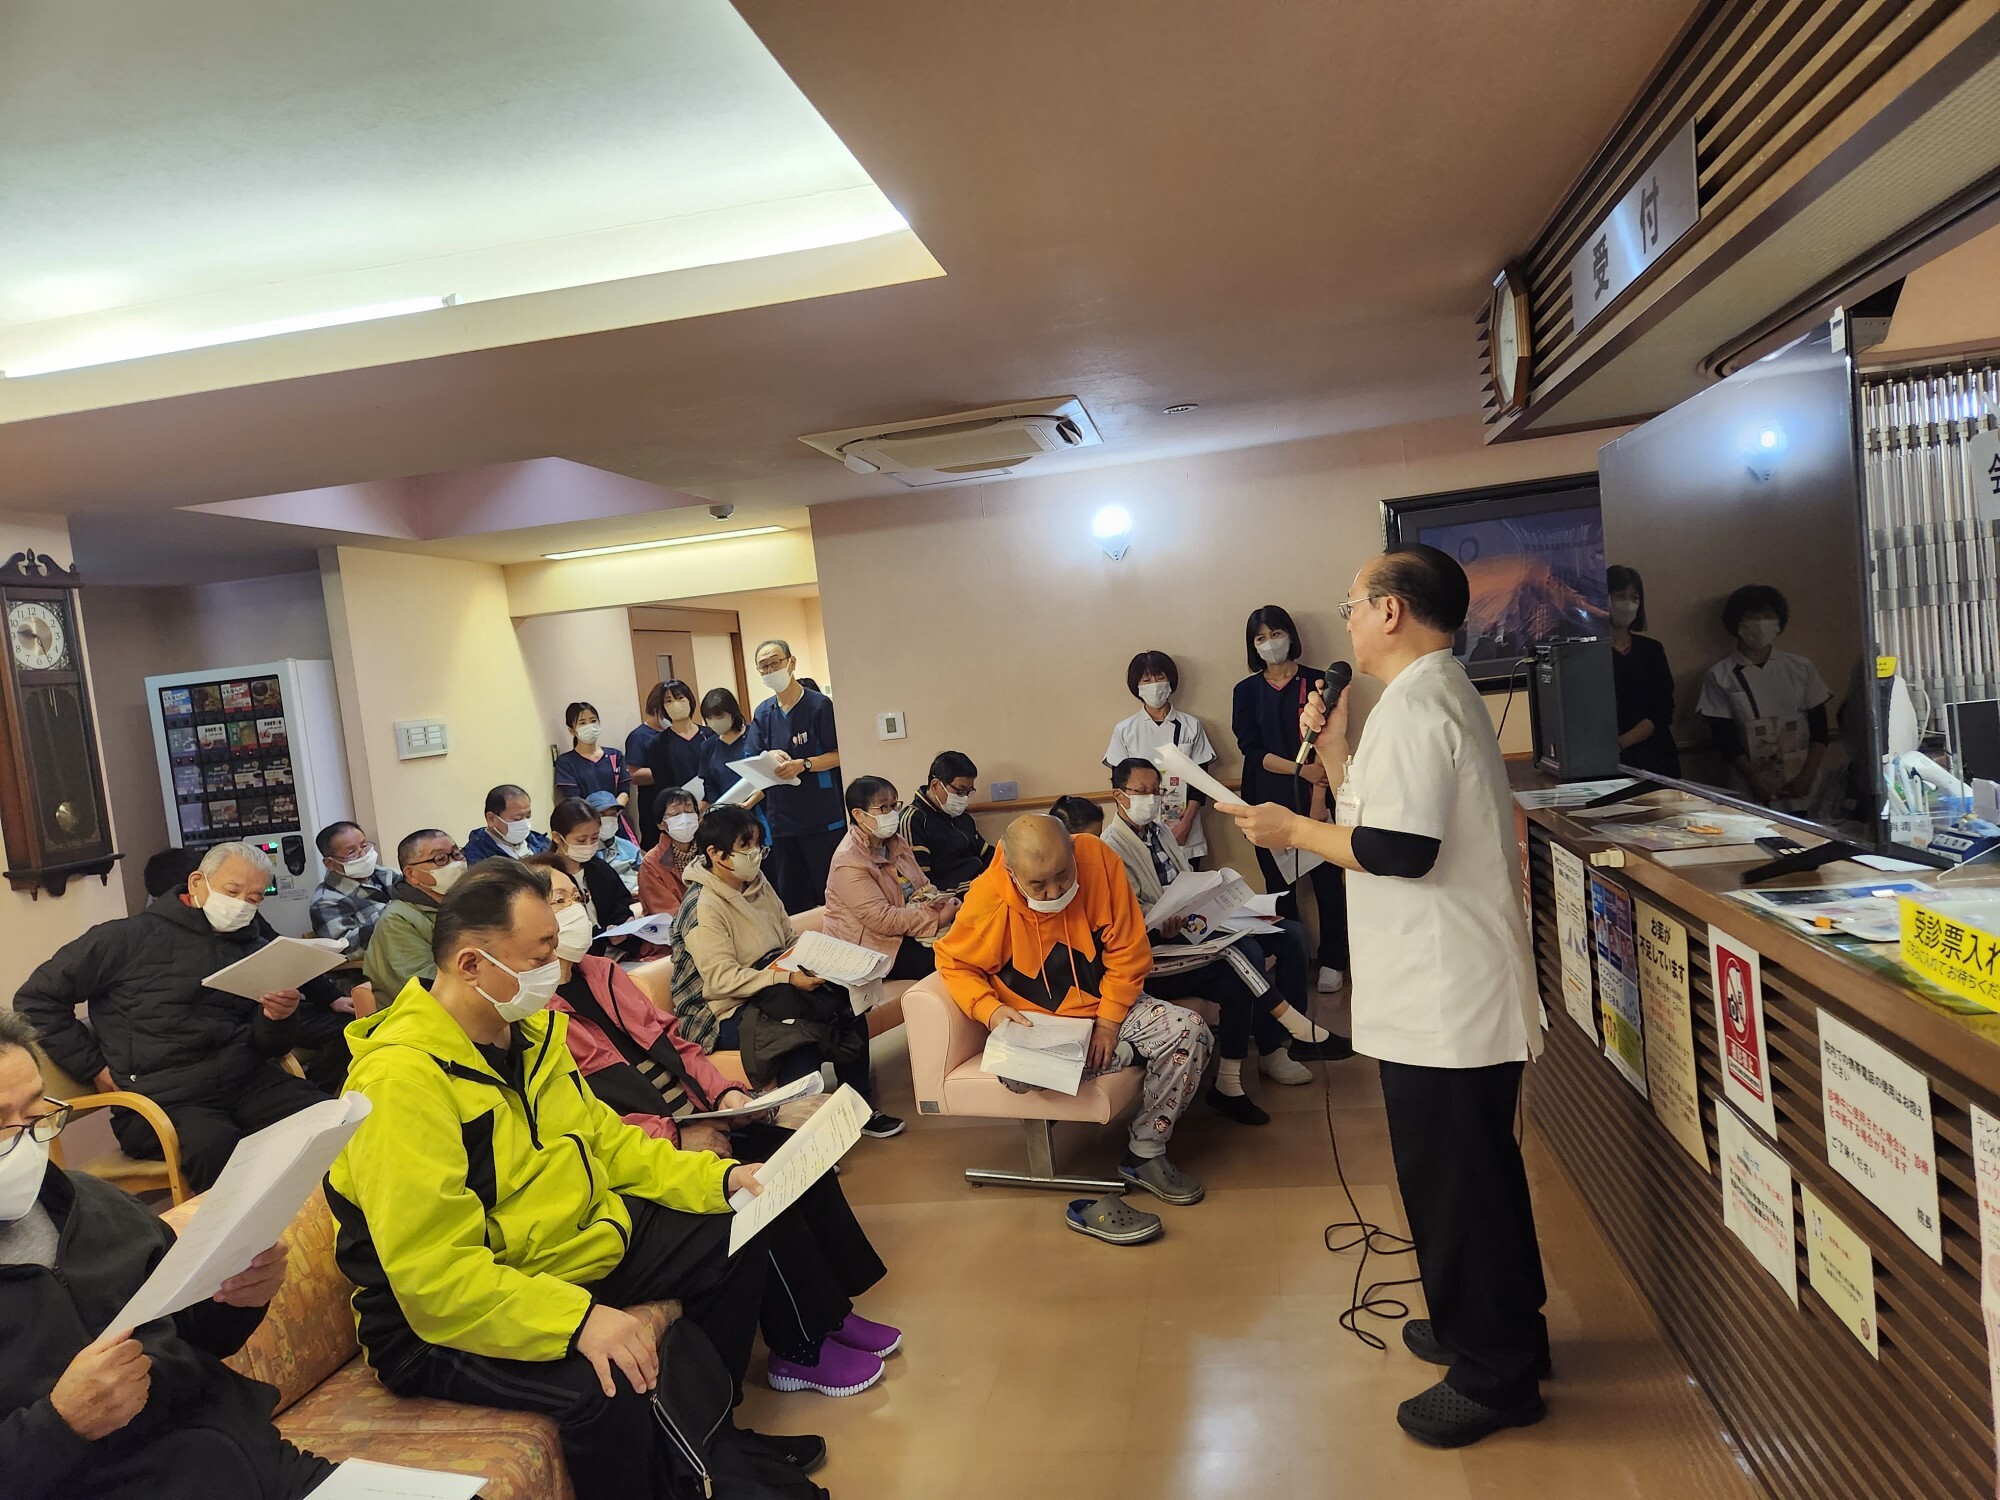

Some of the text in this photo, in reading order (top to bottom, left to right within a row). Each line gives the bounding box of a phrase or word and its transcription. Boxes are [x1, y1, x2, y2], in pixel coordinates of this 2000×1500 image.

[1593, 175, 1660, 302] 受付
[17, 610, 24, 619] 11
[27, 607, 37, 616] 12
[10, 619, 18, 628] 10
[11, 632, 16, 640] 9
[54, 632, 60, 640] 3
[15, 645, 21, 653] 8
[53, 644, 59, 653] 4
[25, 654, 30, 663] 7
[37, 657, 43, 665] 6
[1651, 917, 1671, 946] お薬が
[1639, 934, 1685, 984] 不足しています
[1906, 940, 2000, 1001] こちらに入れてお待ちくだ
[1826, 1058, 1851, 1081] ください
[1823, 1039, 1925, 1122] 院内での携帯電話の使用はお控え
[1829, 1105, 1907, 1174] を中断する場合があります
[1831, 1136, 1876, 1178] ご了承ください
[1917, 1206, 1933, 1232] 院長
